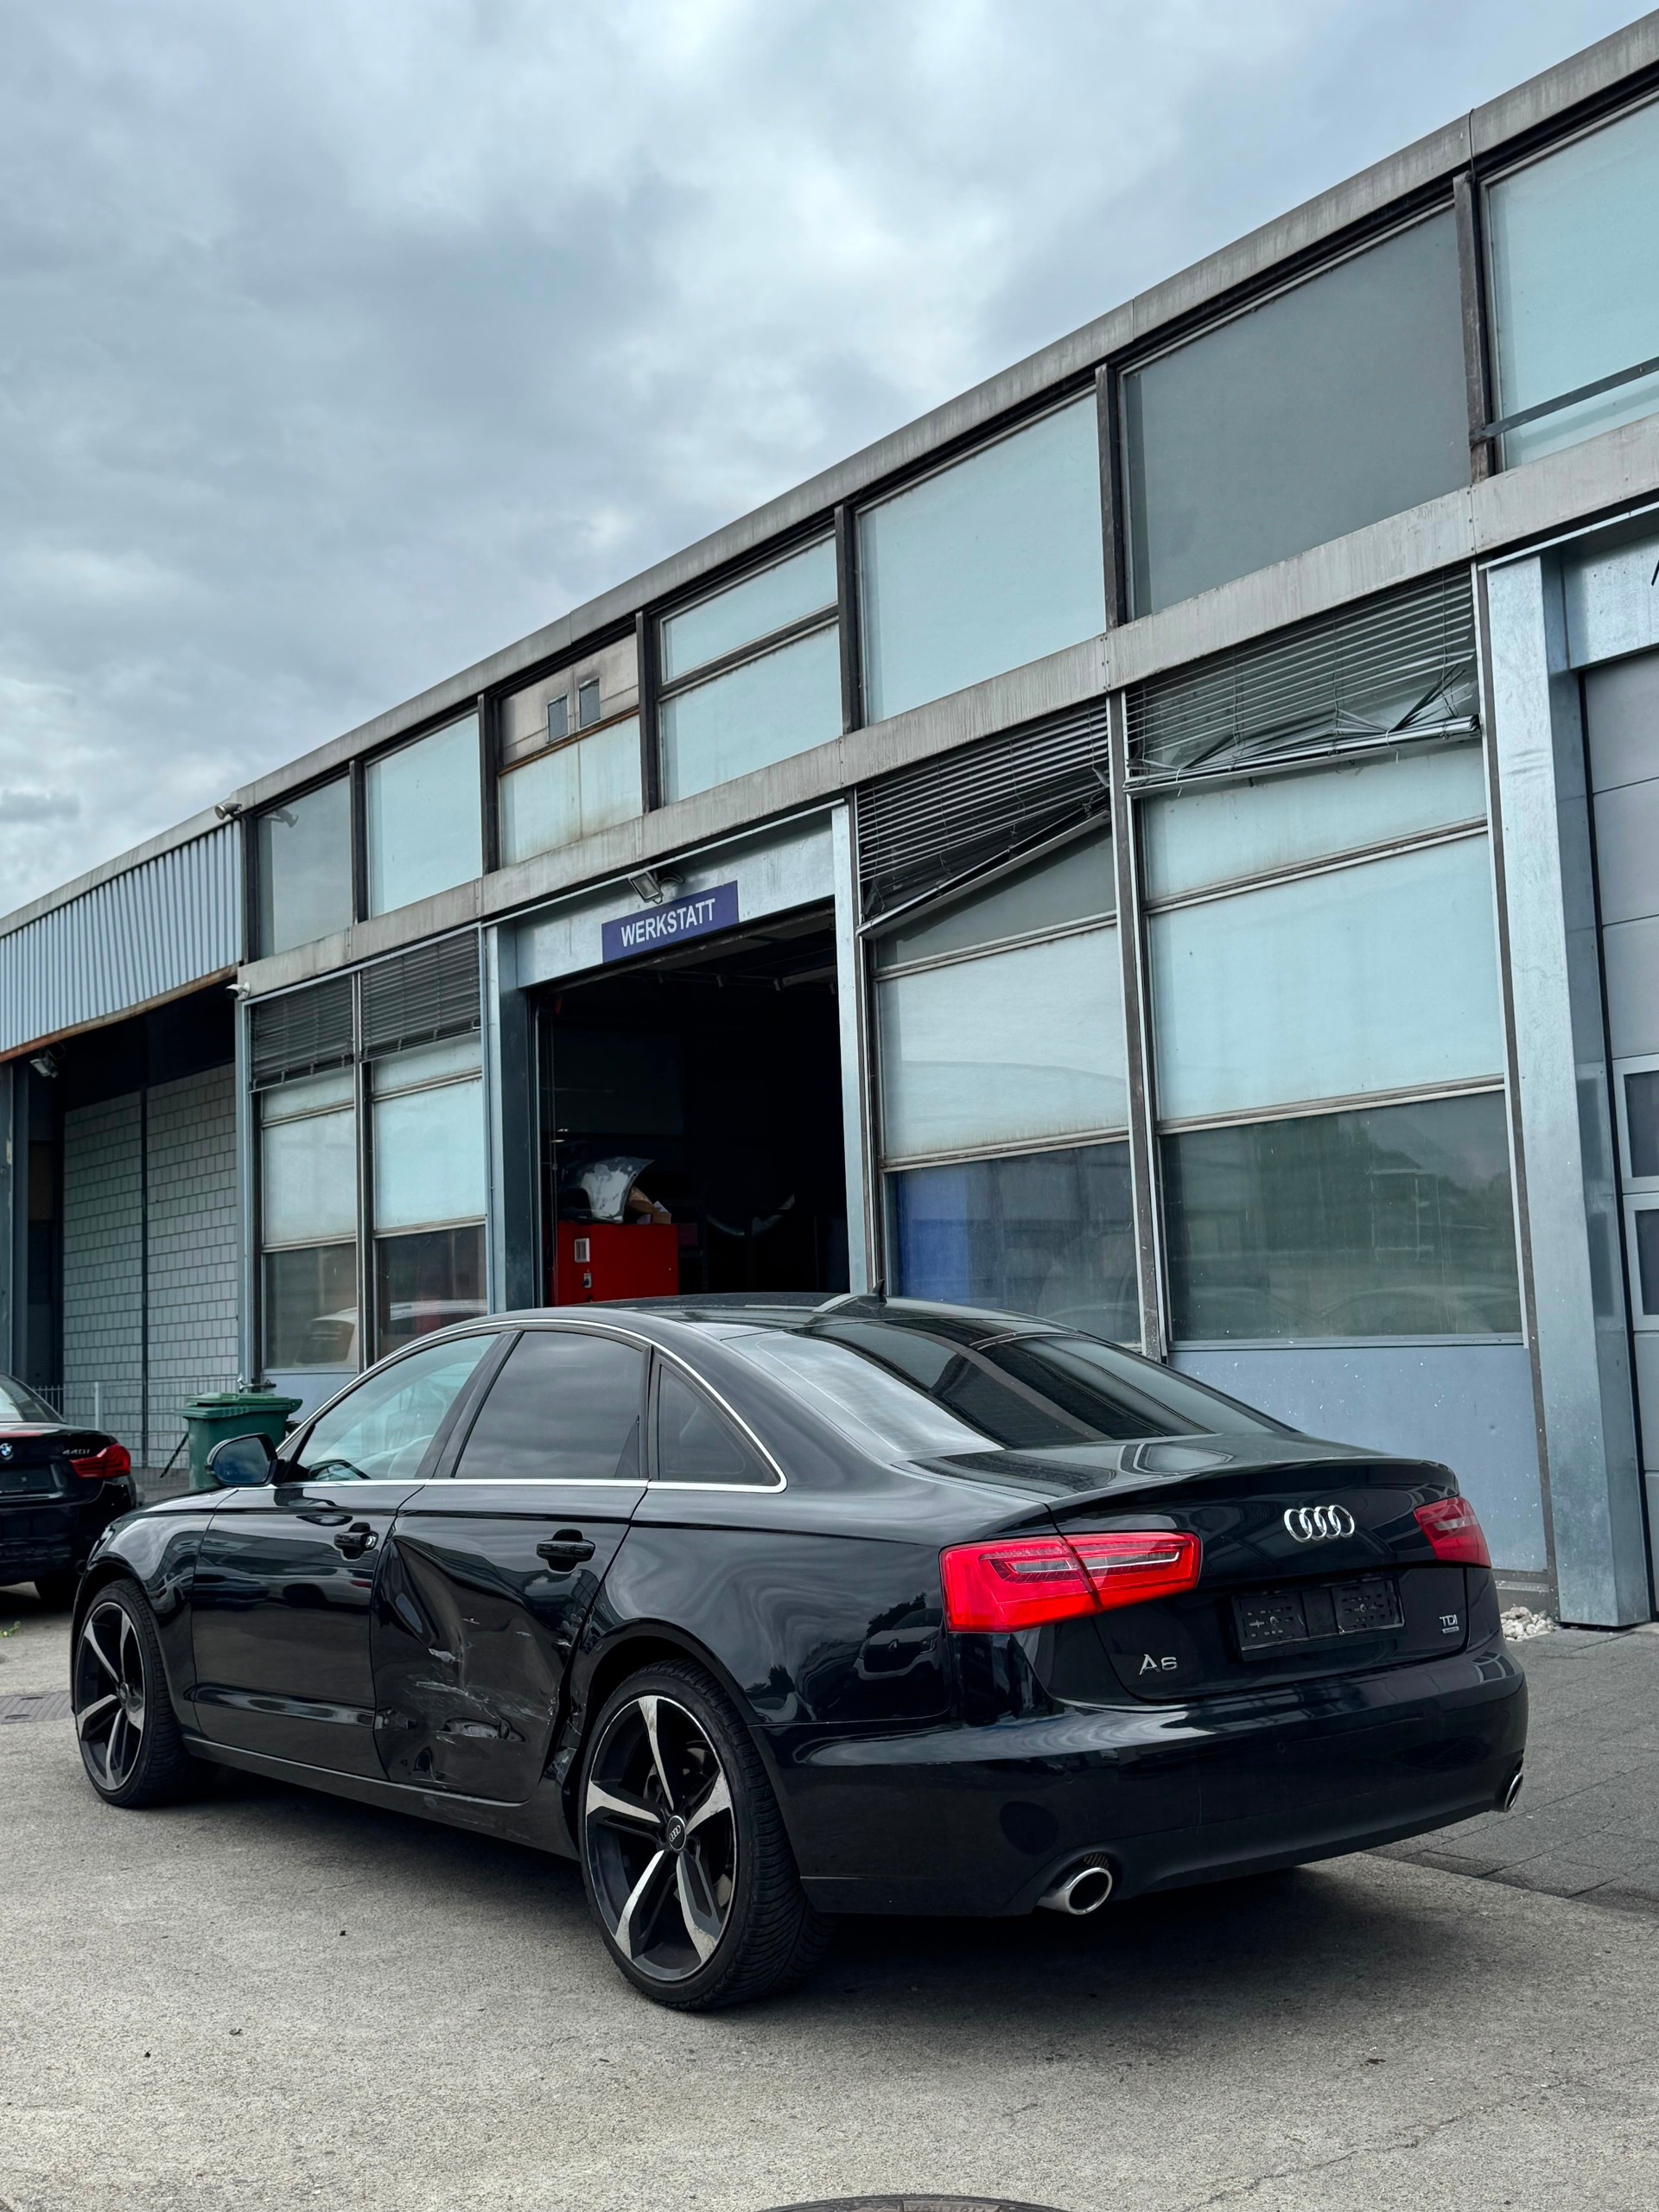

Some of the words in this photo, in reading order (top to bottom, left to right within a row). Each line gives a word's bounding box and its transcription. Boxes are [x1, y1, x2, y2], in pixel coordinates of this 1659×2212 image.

[620, 898, 715, 947] WERKSTATT
[1439, 1614, 1458, 1627] TDI
[1139, 1654, 1178, 1675] A6
